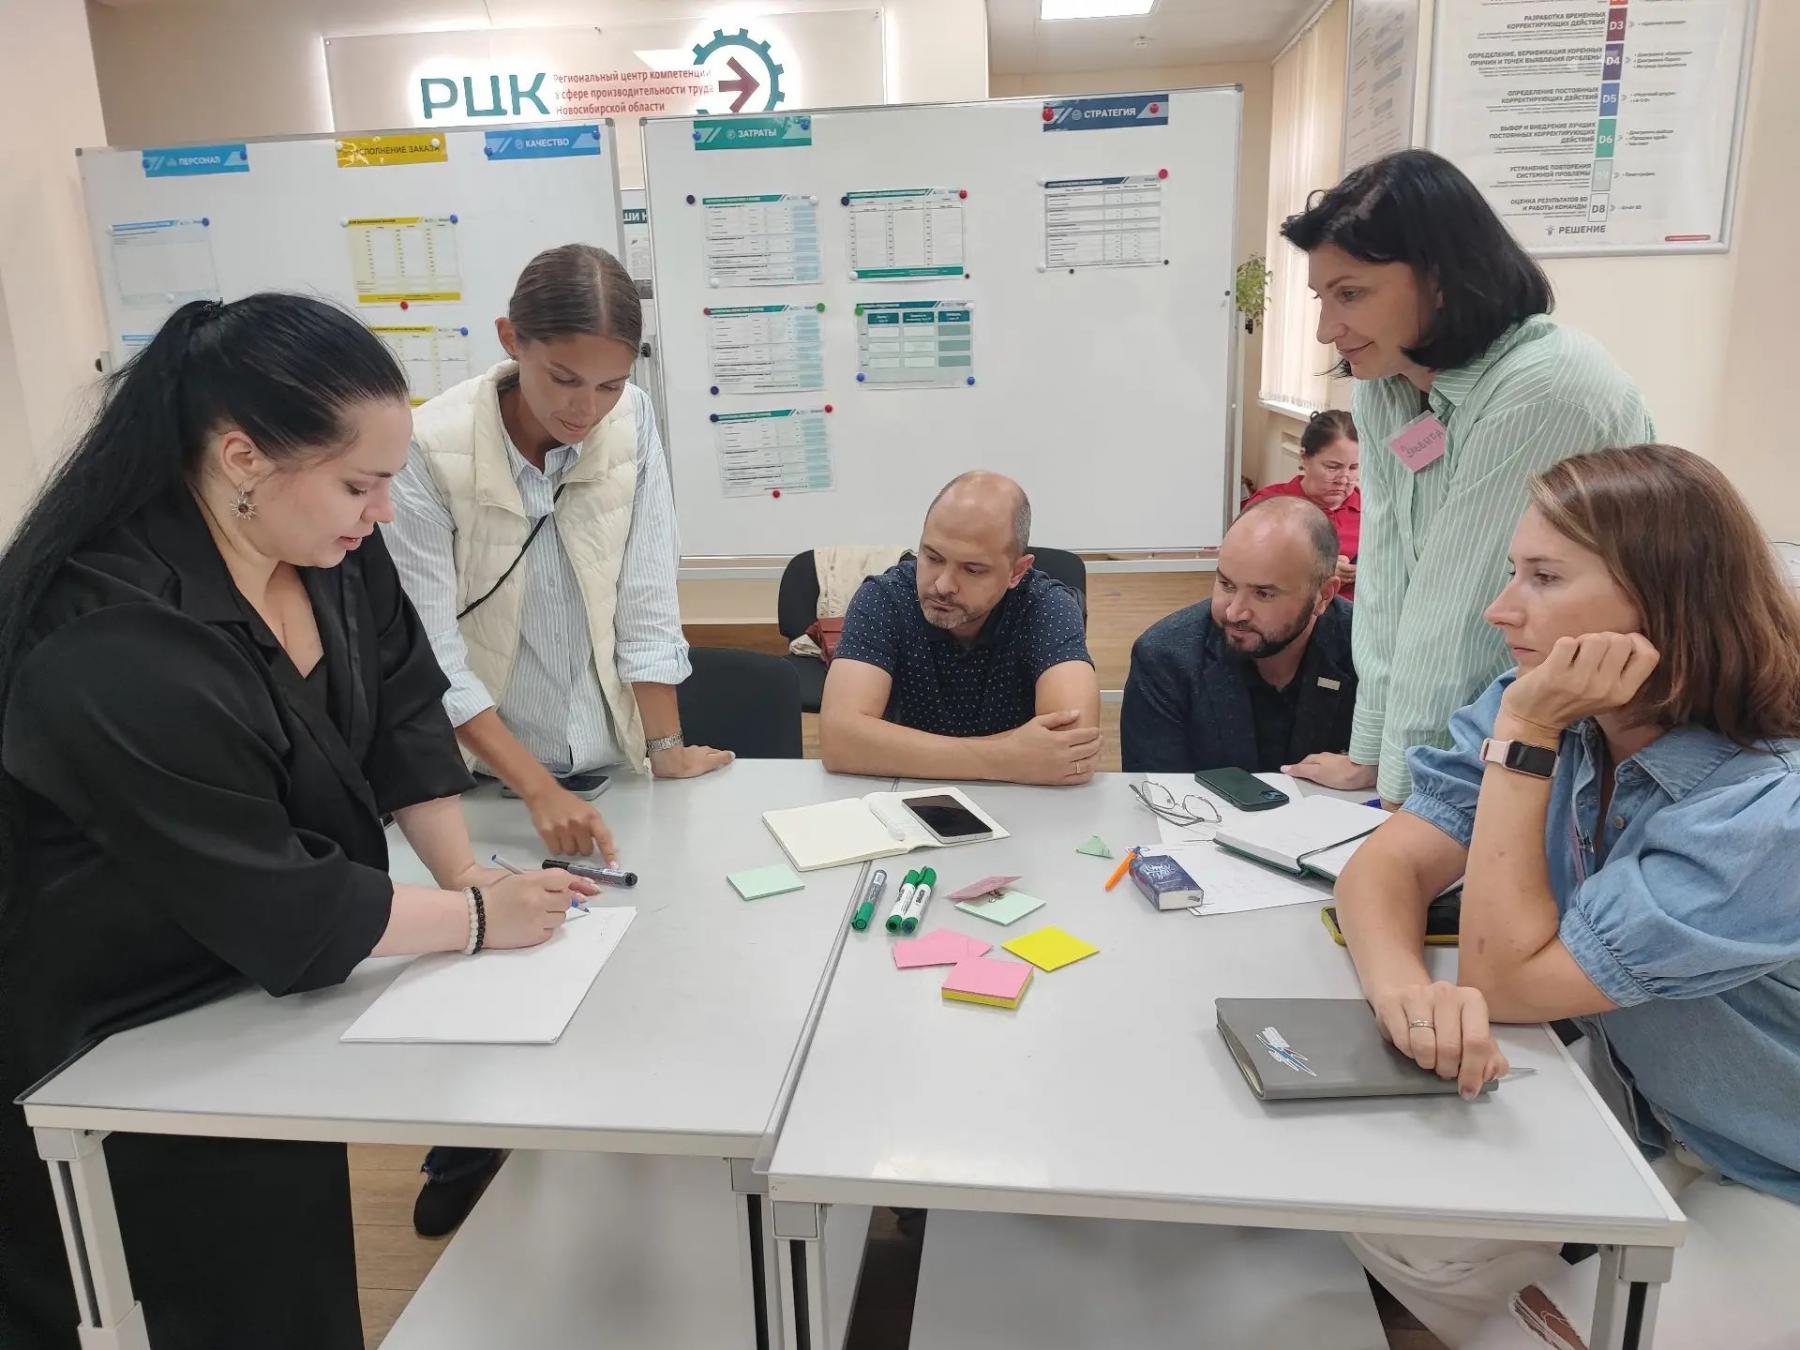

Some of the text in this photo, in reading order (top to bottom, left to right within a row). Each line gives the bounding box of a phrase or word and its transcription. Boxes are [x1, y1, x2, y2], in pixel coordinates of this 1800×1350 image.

[1610, 21, 1624, 30] D3
[1606, 56, 1621, 66] D4
[553, 70, 619, 84] Региональный
[620, 71, 648, 83] центр
[420, 72, 550, 119] РЦК
[562, 88, 589, 101] сфере
[590, 85, 686, 99] производительности
[688, 84, 714, 96] труда
[1602, 94, 1617, 103] D5
[556, 101, 665, 116] Новосибирской области
[1084, 107, 1137, 119] СТРАТЕГИЯ
[737, 128, 777, 139] ЗАТРАТЫ
[525, 137, 570, 149] КАЧЕСТВО
[1599, 135, 1613, 144] D6
[178, 155, 221, 166] ПЕРСОНАЛ
[1592, 204, 1606, 214] D8
[1558, 225, 1607, 235] РЕШЕНИЕ
